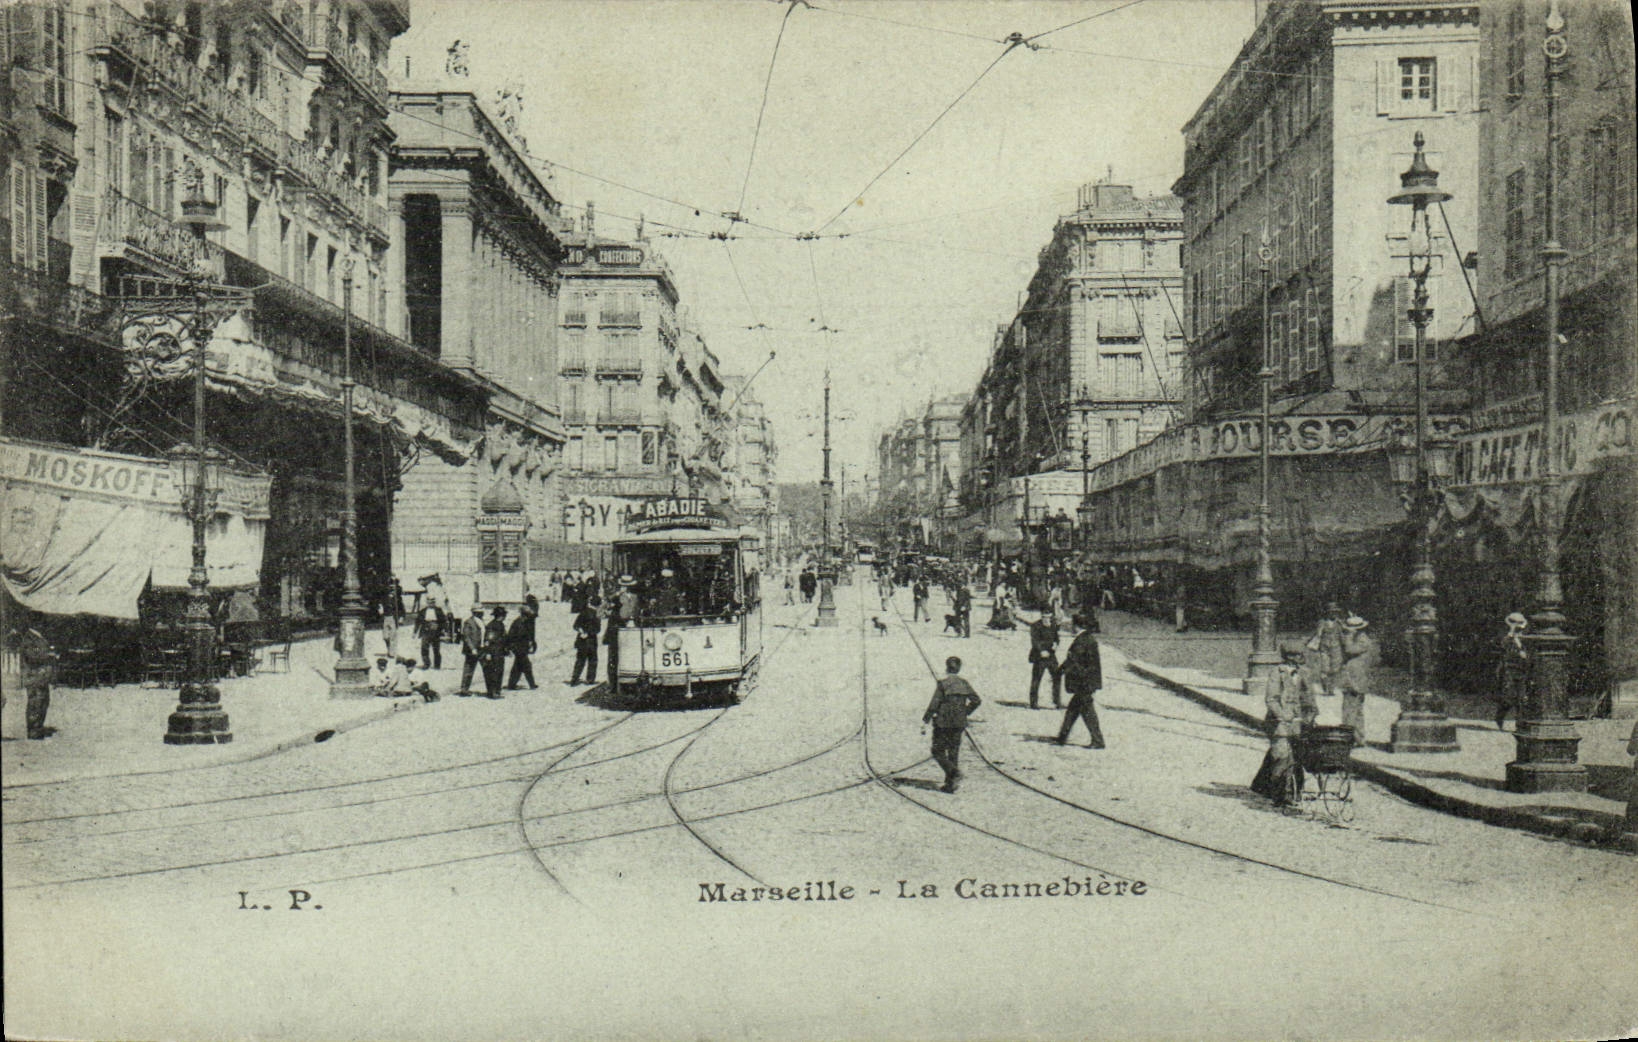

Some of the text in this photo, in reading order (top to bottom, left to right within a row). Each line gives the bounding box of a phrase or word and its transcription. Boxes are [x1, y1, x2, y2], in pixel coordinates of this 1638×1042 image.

[25, 451, 170, 496] MOSKOFF
[646, 499, 706, 518] ABADIE
[662, 652, 690, 667] 561
